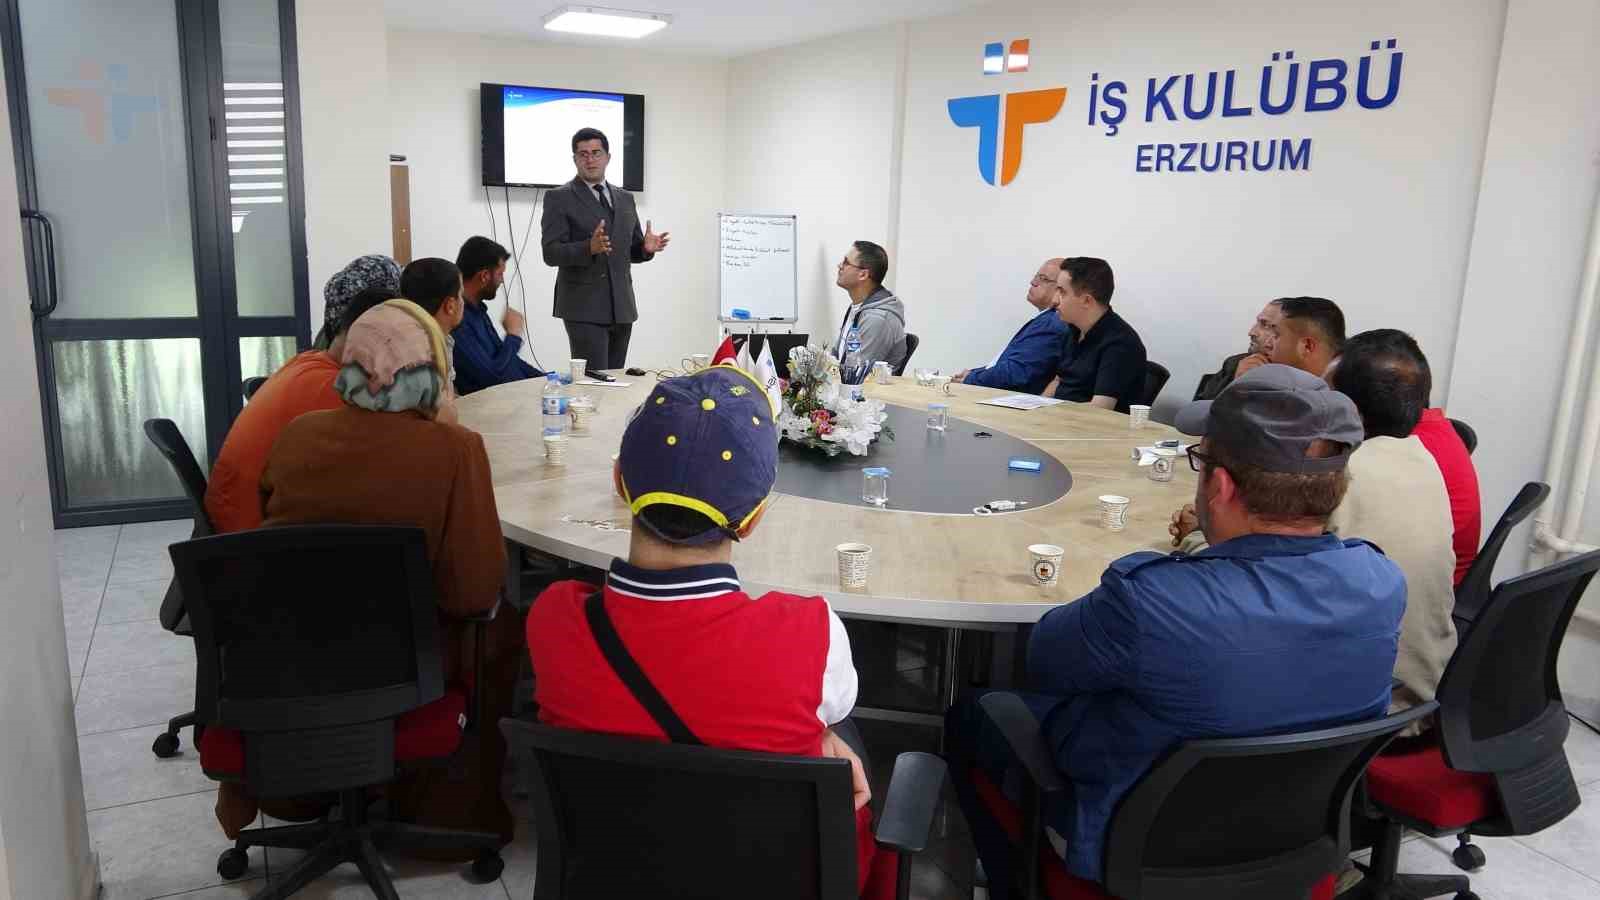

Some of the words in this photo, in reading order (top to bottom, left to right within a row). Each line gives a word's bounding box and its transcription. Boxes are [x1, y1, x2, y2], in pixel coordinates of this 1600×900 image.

[1088, 73, 1128, 137] İŞ
[1145, 38, 1404, 122] KULÜBÜ
[1135, 137, 1313, 172] ERZURUM
